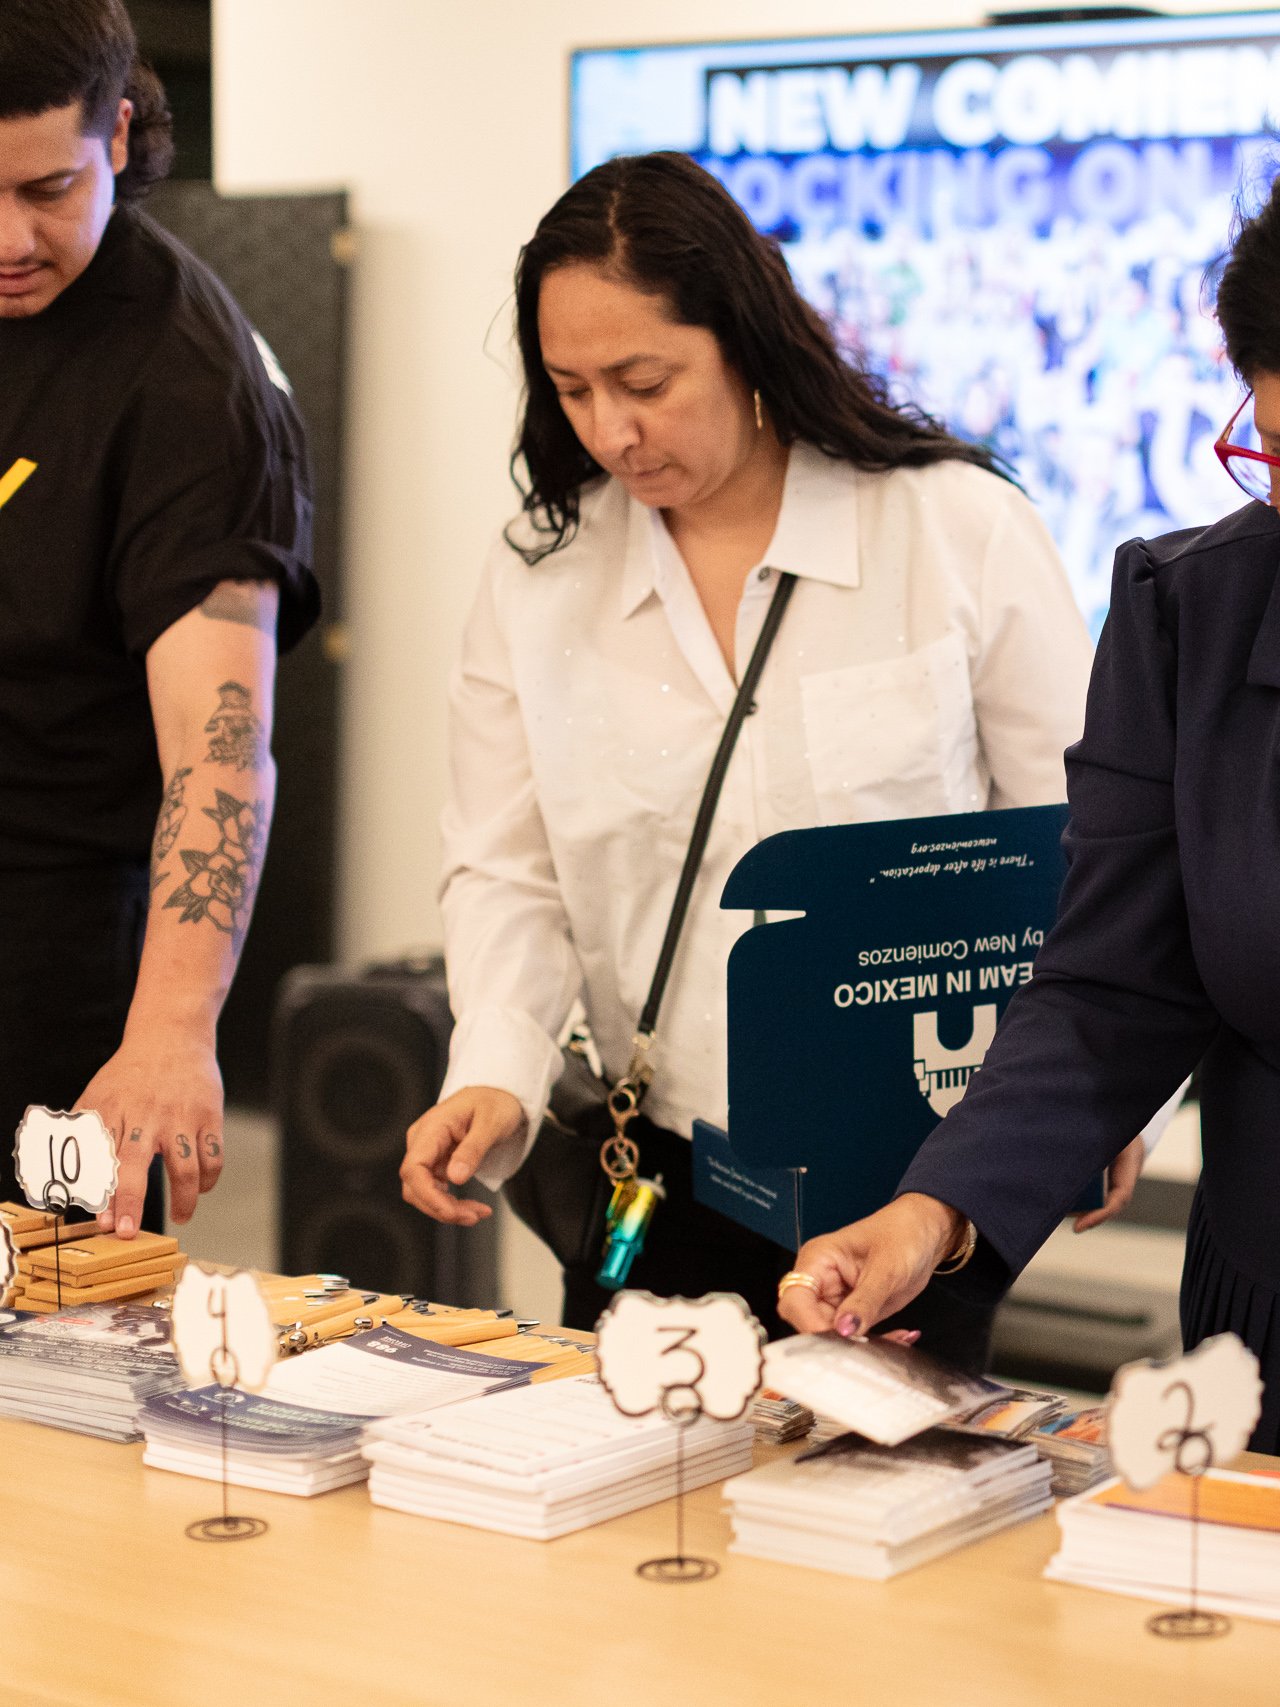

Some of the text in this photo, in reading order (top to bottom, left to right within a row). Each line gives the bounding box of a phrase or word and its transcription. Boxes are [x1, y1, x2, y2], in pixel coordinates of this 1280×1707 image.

[708, 62, 922, 156] NEW
[1070, 138, 1215, 226] ON
[910, 838, 997, 854] newcomienzos.org
[943, 860, 969, 875] after
[971, 858, 986, 873] life
[988, 858, 998, 868] is
[858, 926, 1044, 966] by New Comienzos
[833, 962, 1035, 1008] EAM IN MEXICO
[49, 1134, 81, 1184] 10
[657, 1326, 705, 1393] 3
[1157, 1380, 1215, 1452] 2
